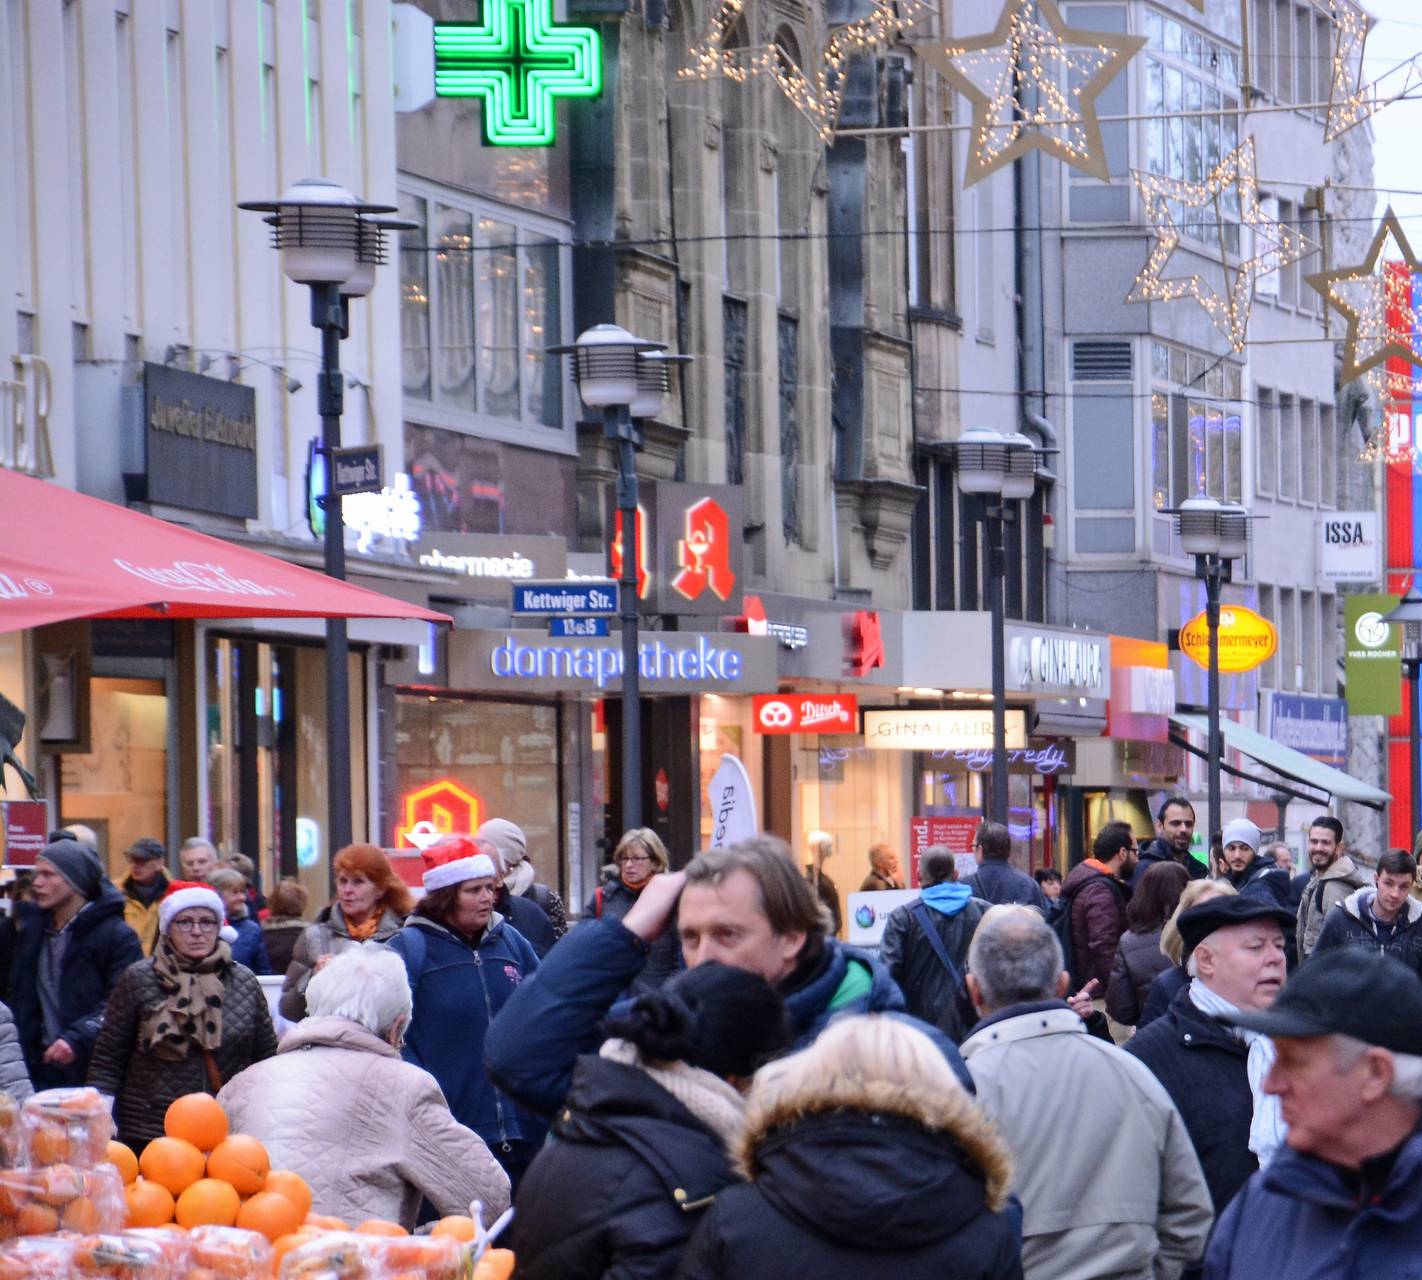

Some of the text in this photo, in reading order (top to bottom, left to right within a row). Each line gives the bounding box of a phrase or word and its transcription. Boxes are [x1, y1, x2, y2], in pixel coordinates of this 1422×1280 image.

[1325, 521, 1363, 544] ISSA
[523, 589, 613, 612] Kettwiger Str.
[491, 634, 743, 688] domaptheke
[1349, 650, 1397, 658] YVES ROCHER
